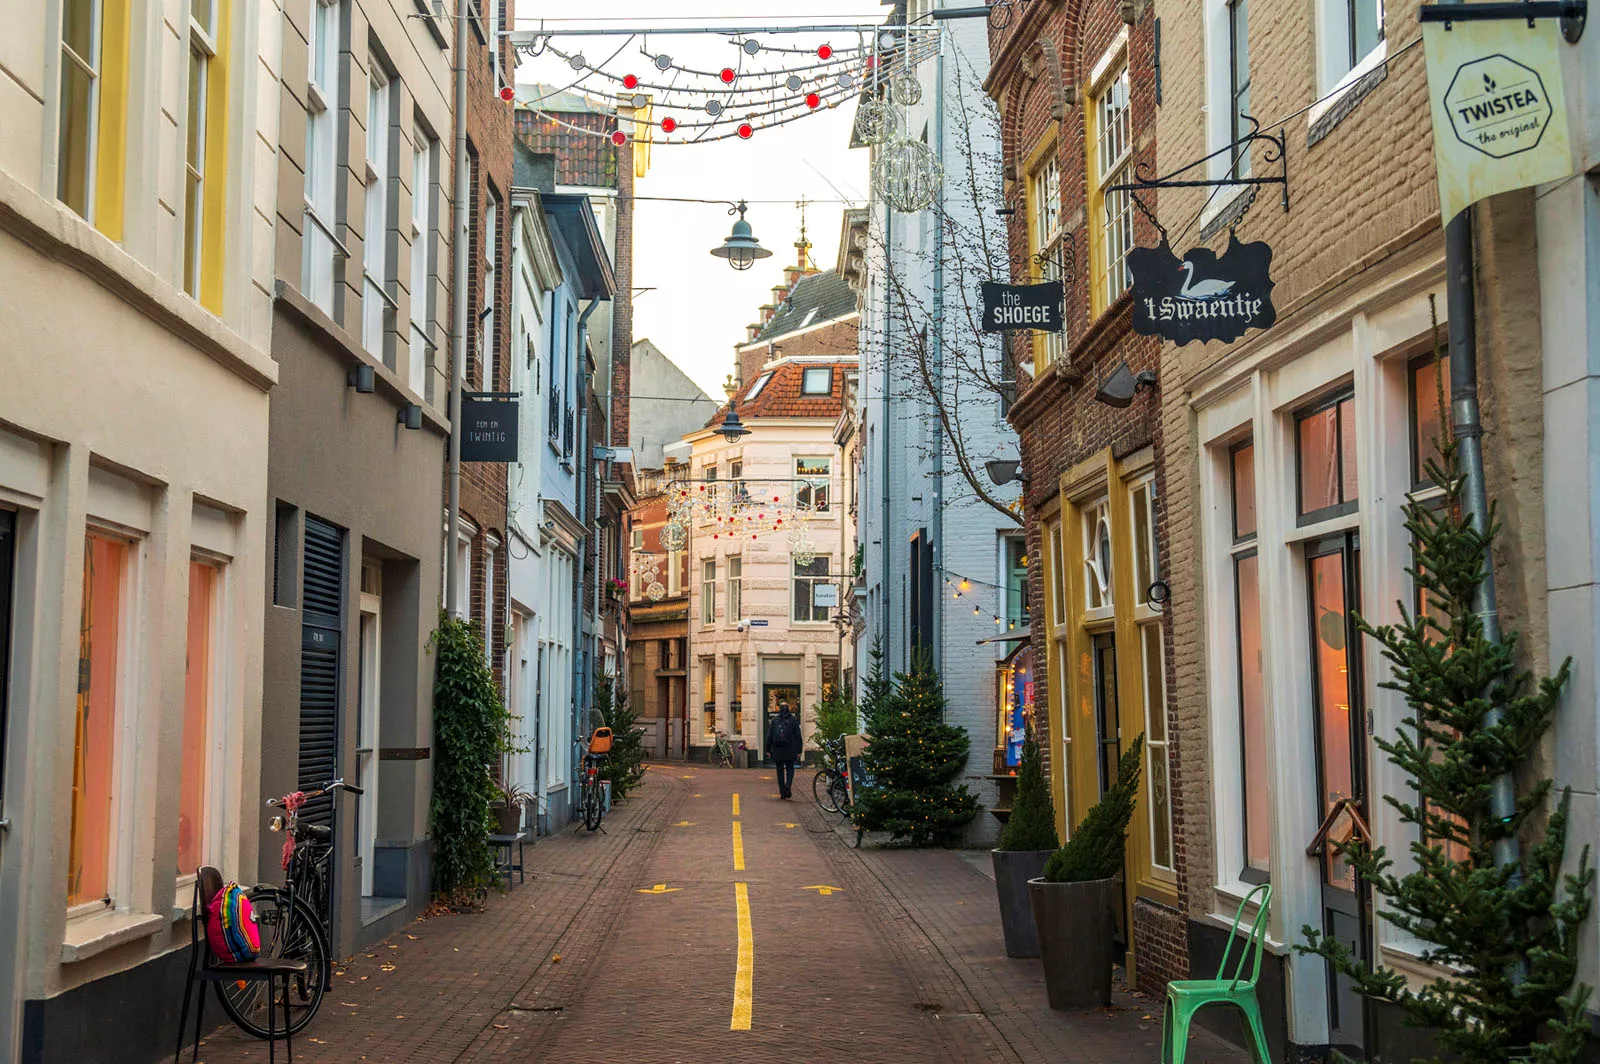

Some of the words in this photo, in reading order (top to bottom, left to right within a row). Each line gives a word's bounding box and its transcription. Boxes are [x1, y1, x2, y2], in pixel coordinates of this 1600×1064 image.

[1458, 88, 1538, 125] TWISTEA
[1475, 131, 1497, 145] the
[1500, 117, 1540, 138] original
[1002, 290, 1020, 306] the
[1158, 292, 1263, 323] Swaentje
[993, 305, 1051, 324] SHOEGE
[470, 431, 506, 442] TWINTIG
